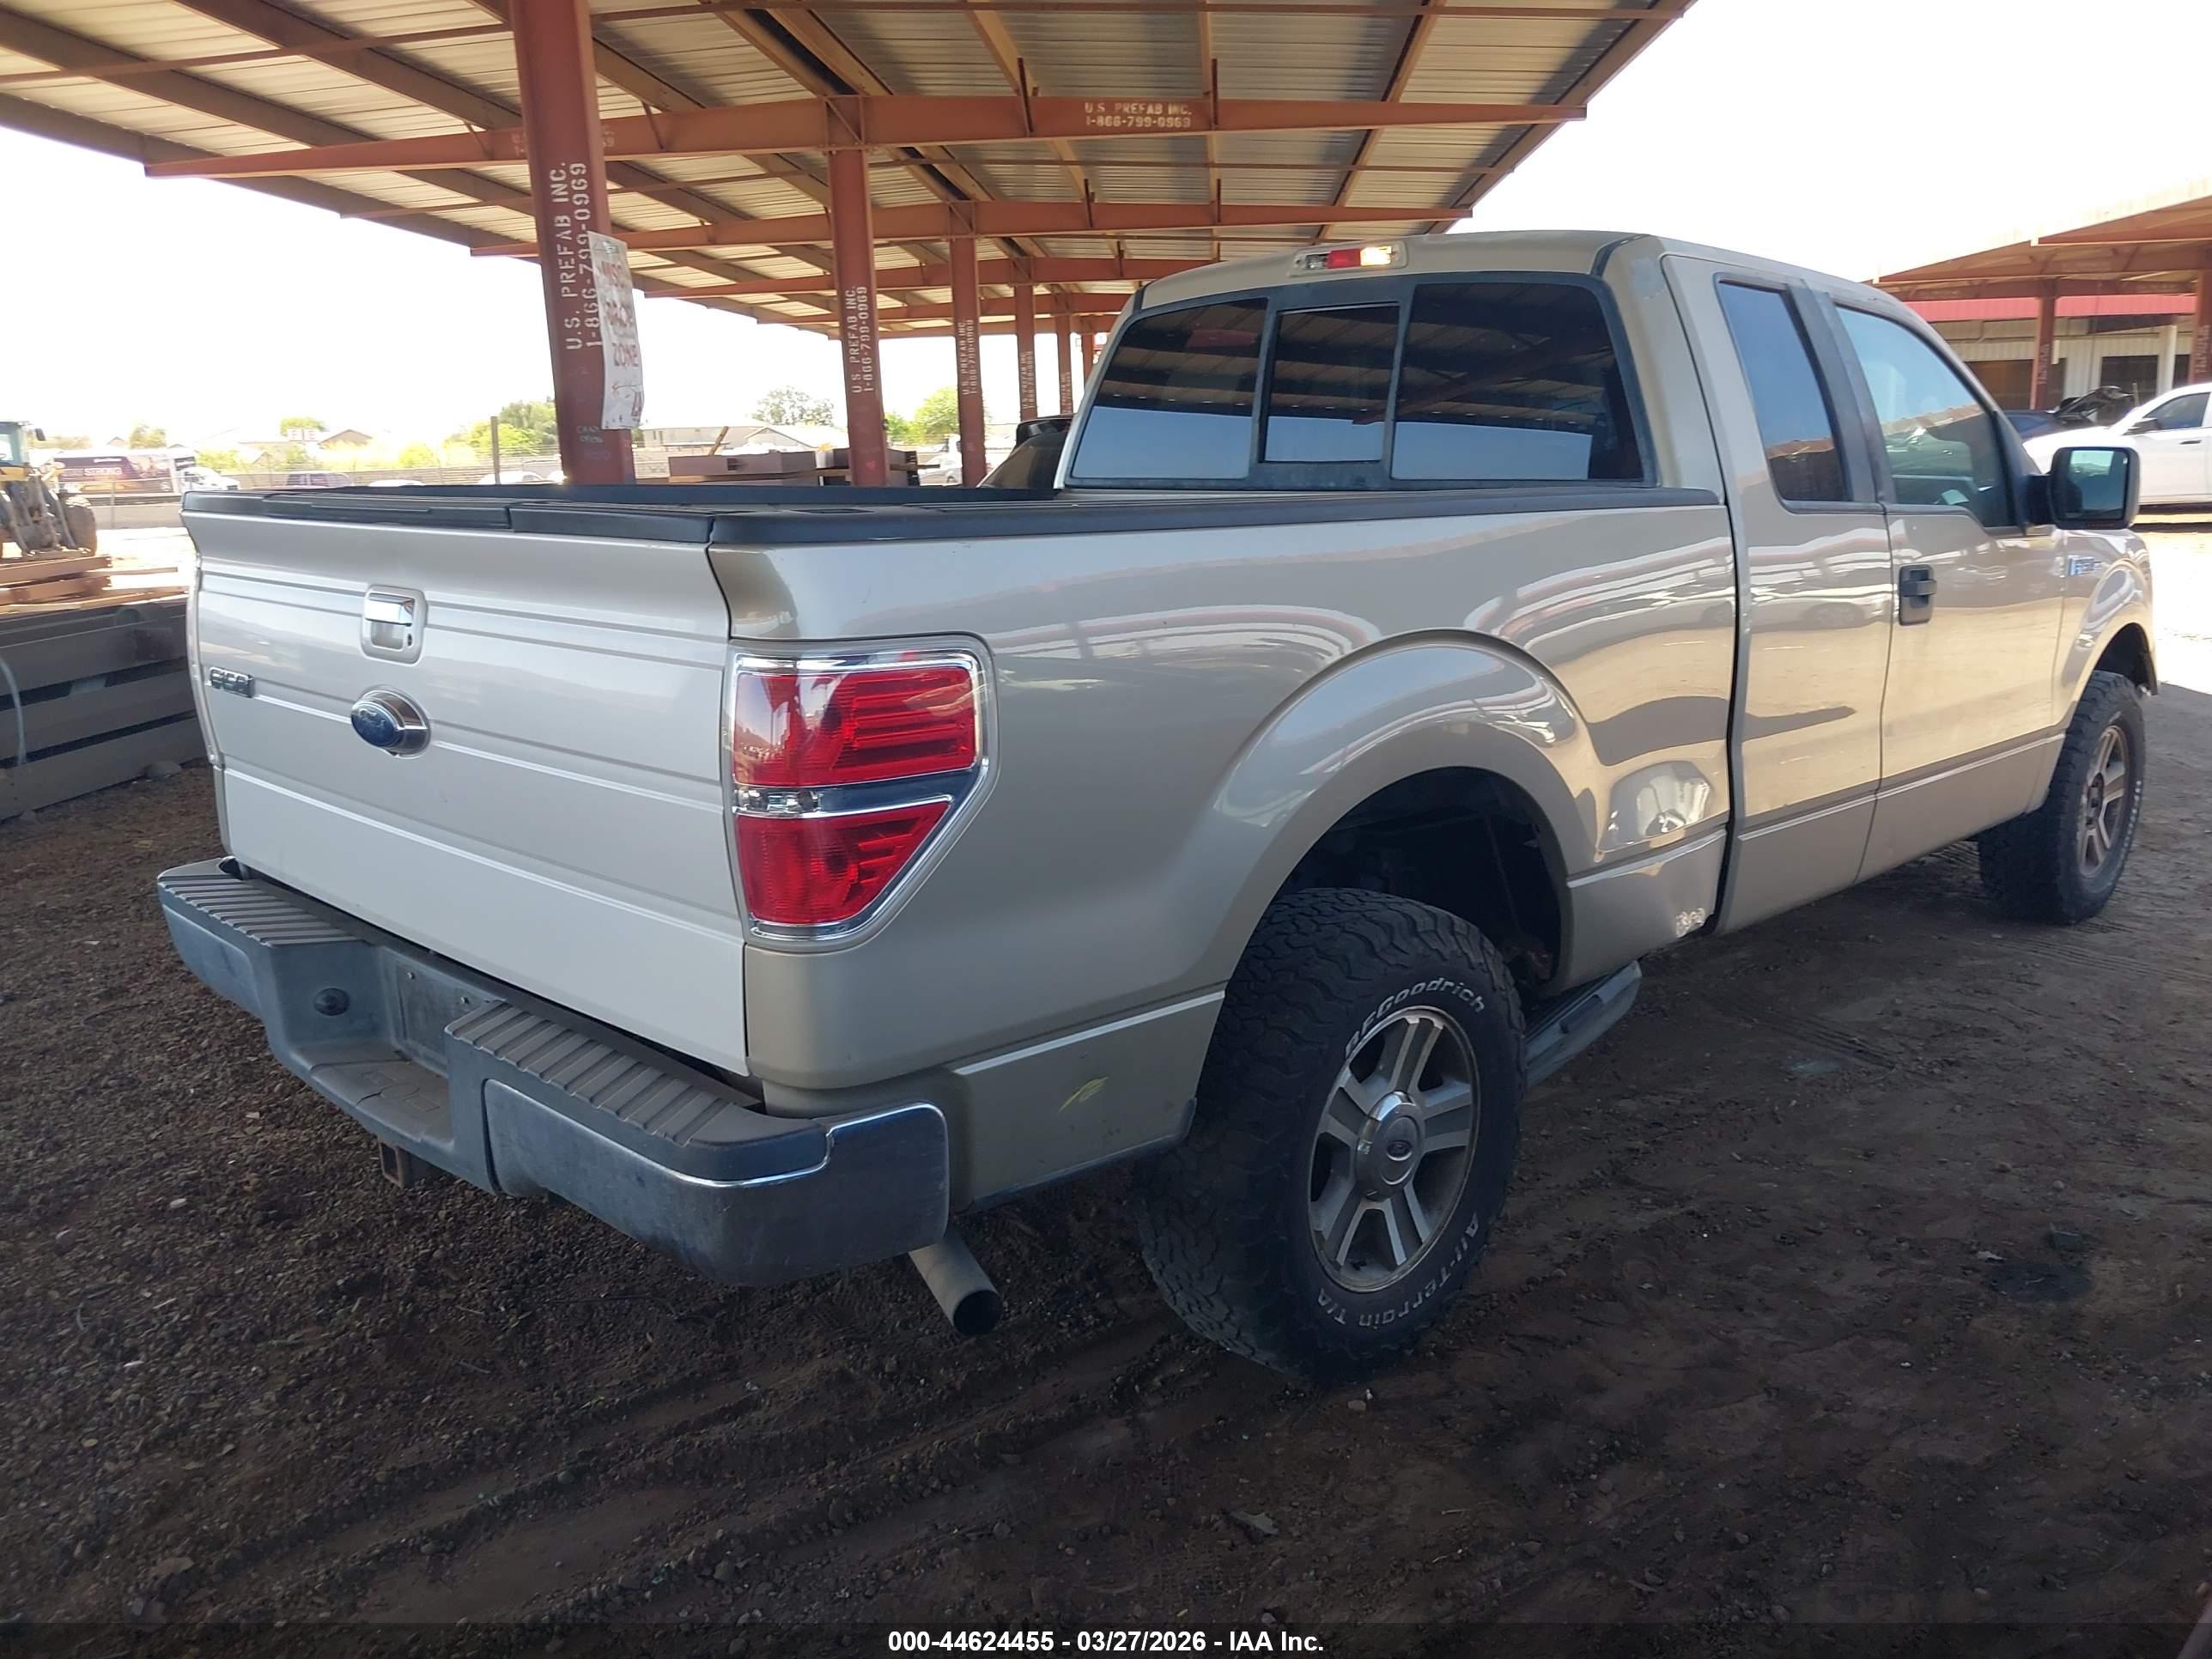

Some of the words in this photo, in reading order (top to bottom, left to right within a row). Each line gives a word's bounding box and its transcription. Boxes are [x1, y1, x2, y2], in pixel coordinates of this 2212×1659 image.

[1086, 115, 1191, 128] 1-866-799-0969
[1115, 103, 1164, 115] PREFAB
[549, 161, 570, 203] INC.
[554, 214, 579, 297] PREFAB
[564, 311, 583, 350] U.S.
[848, 315, 861, 363] PREFAB
[1345, 976, 1486, 1060] BFGoodrich
[1358, 1210, 1481, 1330] All-Terrain
